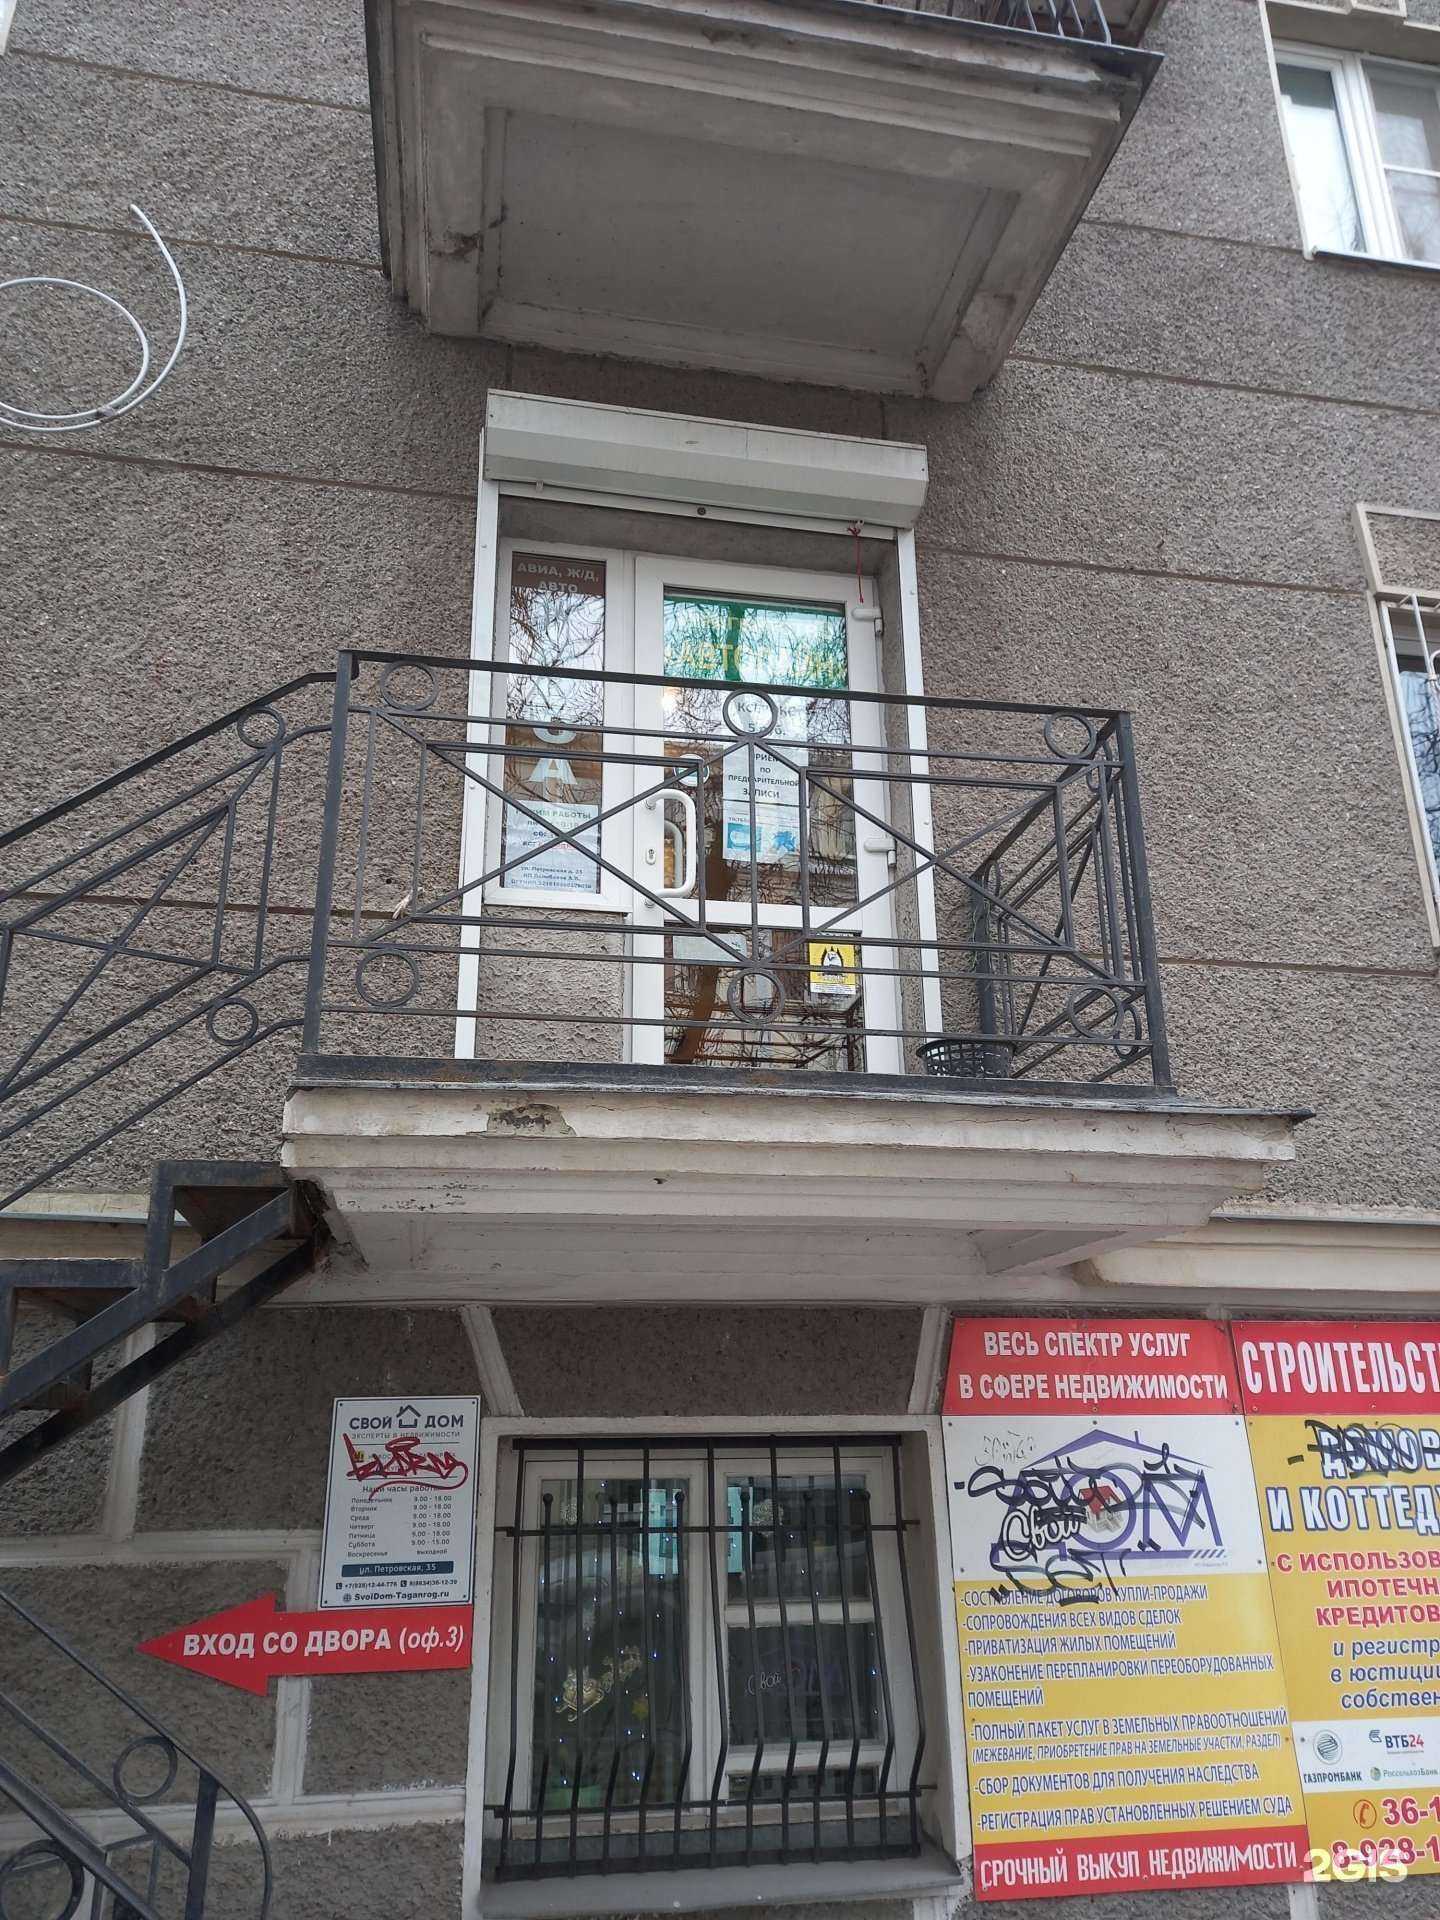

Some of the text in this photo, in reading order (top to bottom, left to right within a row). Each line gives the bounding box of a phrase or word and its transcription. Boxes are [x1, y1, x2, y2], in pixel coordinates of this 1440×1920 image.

[517, 562, 599, 582] АВИА, Ж/Д,
[538, 581, 578, 593] АВТО
[743, 788, 780, 799] ЗПИСИ
[984, 1332, 1191, 1357] ВЕСЬ СПЕКТР УСЛУГ
[1242, 1341, 1440, 1394] СТРОИТЕЛЬСТ
[959, 1374, 1228, 1403] В СФЕРЕ НЕДВИЖИМОСТИ
[349, 1415, 464, 1430] СВОЙ ДОМ
[352, 1432, 390, 1440] ЭКСПЕРТЫ
[1265, 1485, 1440, 1537] И КОТТЕД
[374, 1564, 424, 1574] Петровская,
[1277, 1551, 1440, 1571] С ИСПОЛЬЗОВ
[961, 1589, 1044, 1606] -СОСТВЛЕНИЕ
[1115, 1585, 1208, 1603] КУПЛИ-ПРОДАЖИ
[963, 1609, 1181, 1631] -СОПРОВОЖДЕНИЯ ВСЕХ ВИДОВ СДЕЛОК
[1316, 1604, 1440, 1628] КРЕДИТОВ
[183, 1625, 464, 1659] ВХОД СО ДВОРА (оф.3)
[965, 1630, 1176, 1656] -ПРИВАТИЗАЦИЯ ЖИЛЫХ ПОМЕЩЕНИЙ
[1333, 1638, 1440, 1660] и регистр
[967, 1655, 1274, 1683] -УЗАКОНЕНИЕ ПЕРЕПЛАНИРОВКИ ПЕРЕОБОРУДОВАННЫХ
[1331, 1668, 1342, 1682] в
[968, 1687, 1044, 1708] ПОМЕЩЕНИЙ
[971, 1707, 1288, 1741] -ПОЛНЫЙ ПАКЕТ УСЛУГ В ЗЕМЕЛЬНЫХ ПРАВООТНОШЕНИЙ
[973, 1732, 1281, 1765] (МЕЖЕВАНИЕ, ПРИОБРЕТЕНИЕ ПРАВ НА ЗЕМЕЛЬНЫЕ УЧАСТКИ, РАЗДЕЛ)
[1384, 1733, 1425, 1749] ВТБ24
[975, 1763, 1259, 1796] -СБОР ДОКУМЕНТОВ ДЛЯ ПОЛУЧЕНИЯ НАСЛЕДСТВА
[1303, 1771, 1363, 1784] ГАЗПРОМБАНК
[977, 1796, 1293, 1831] -РЕГИСТРАЦИЯ ПРАВ УСТАНОВЛЕННЫХ РЕШЕНИЕМ СУДА
[980, 1842, 1297, 1888] СРОЧНЫЙ ВЫКУП НЕДВИЖИМОСТИ
